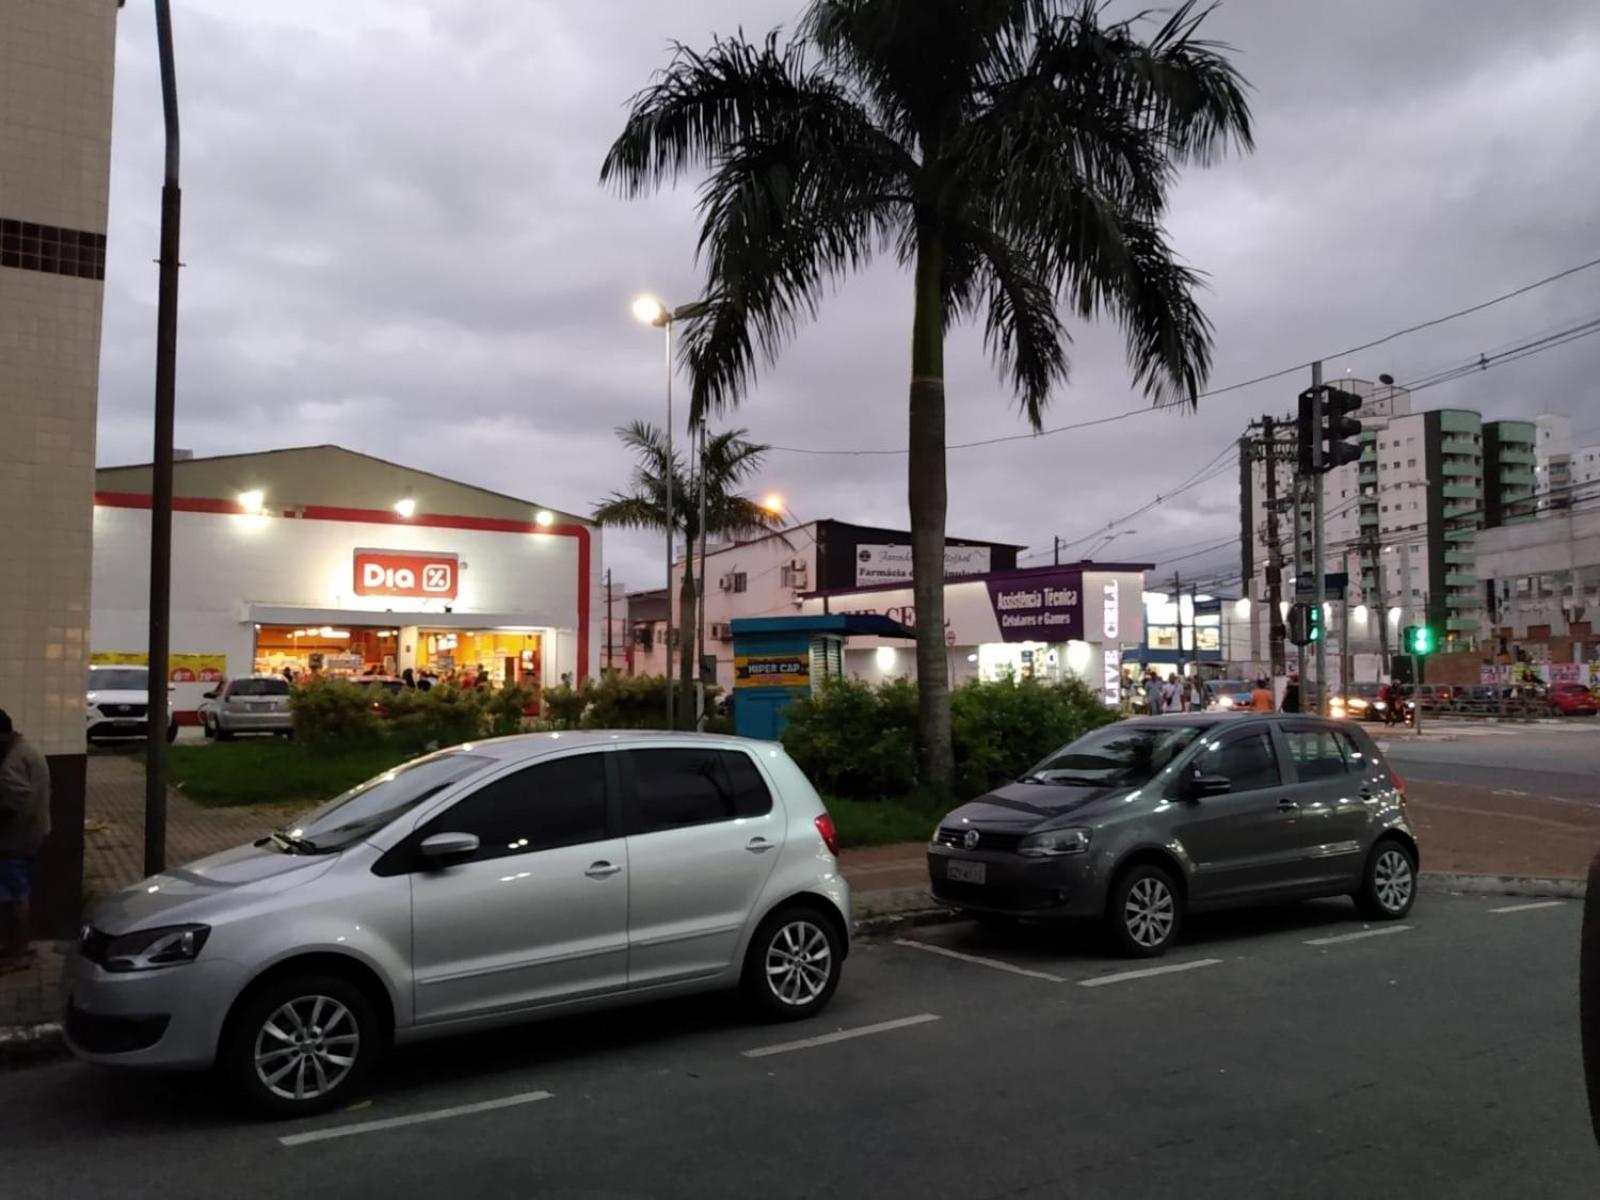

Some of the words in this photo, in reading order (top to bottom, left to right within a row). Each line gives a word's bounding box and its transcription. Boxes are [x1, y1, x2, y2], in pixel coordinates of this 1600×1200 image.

[859, 567, 906, 577] Farmácia
[997, 590, 1042, 610] Assistência
[1043, 587, 1078, 607] Técnica
[1104, 579, 1119, 639] CELL
[1002, 614, 1036, 627] Celulares
[1037, 616, 1043, 625] e
[1043, 612, 1071, 625] Games
[1104, 649, 1121, 705] LIVE
